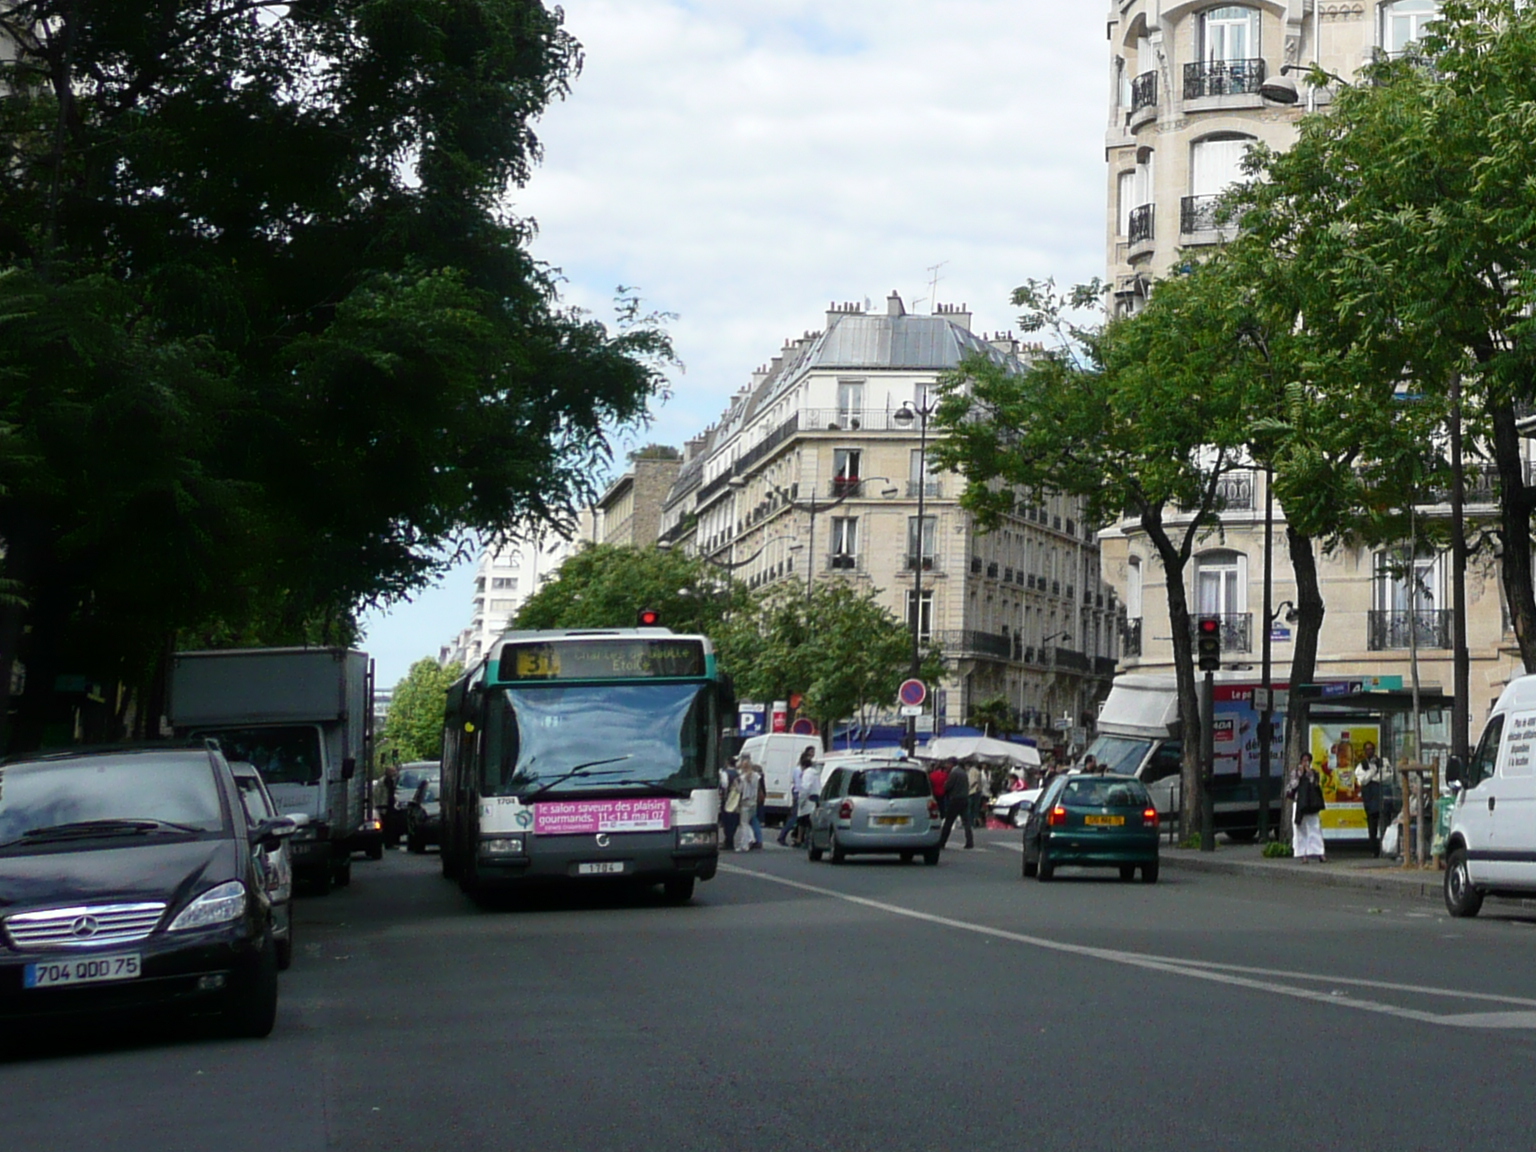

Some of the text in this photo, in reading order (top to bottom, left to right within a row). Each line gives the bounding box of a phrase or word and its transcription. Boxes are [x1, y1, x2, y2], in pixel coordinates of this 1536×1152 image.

[1231, 690, 1240, 700] Le
[741, 713, 755, 731] P
[538, 797, 667, 814] le salon saveurs des plaisirs
[631, 810, 650, 821] mai
[652, 810, 665, 821] 07
[37, 965, 70, 983] 704
[114, 957, 138, 975] 75
